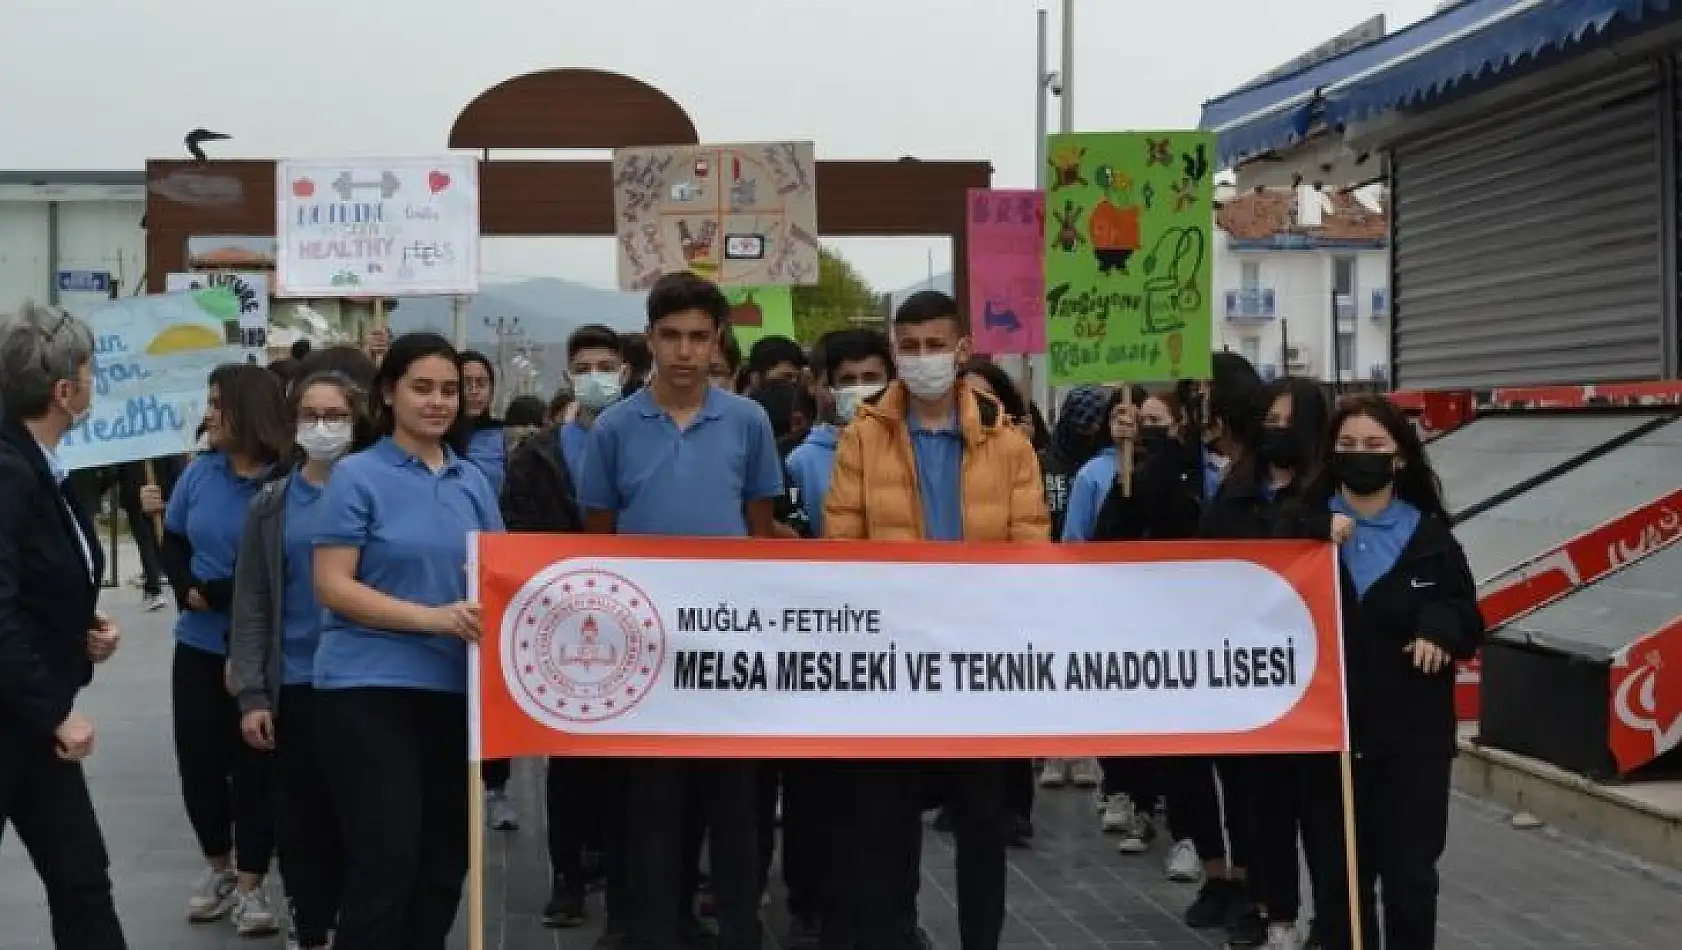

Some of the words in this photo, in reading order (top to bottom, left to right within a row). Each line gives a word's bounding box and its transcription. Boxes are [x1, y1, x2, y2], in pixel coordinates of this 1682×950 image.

[299, 236, 395, 260] HEALTHY
[677, 601, 763, 633] MUĞLA
[782, 602, 881, 634] FETHİYE
[673, 651, 768, 691] MELSA
[776, 640, 896, 692] MESLEKİ
[905, 652, 942, 692] VE
[950, 641, 1056, 692] TEKNİK
[1064, 649, 1197, 691] ANADOLU
[1207, 637, 1297, 688] LİSESİ
